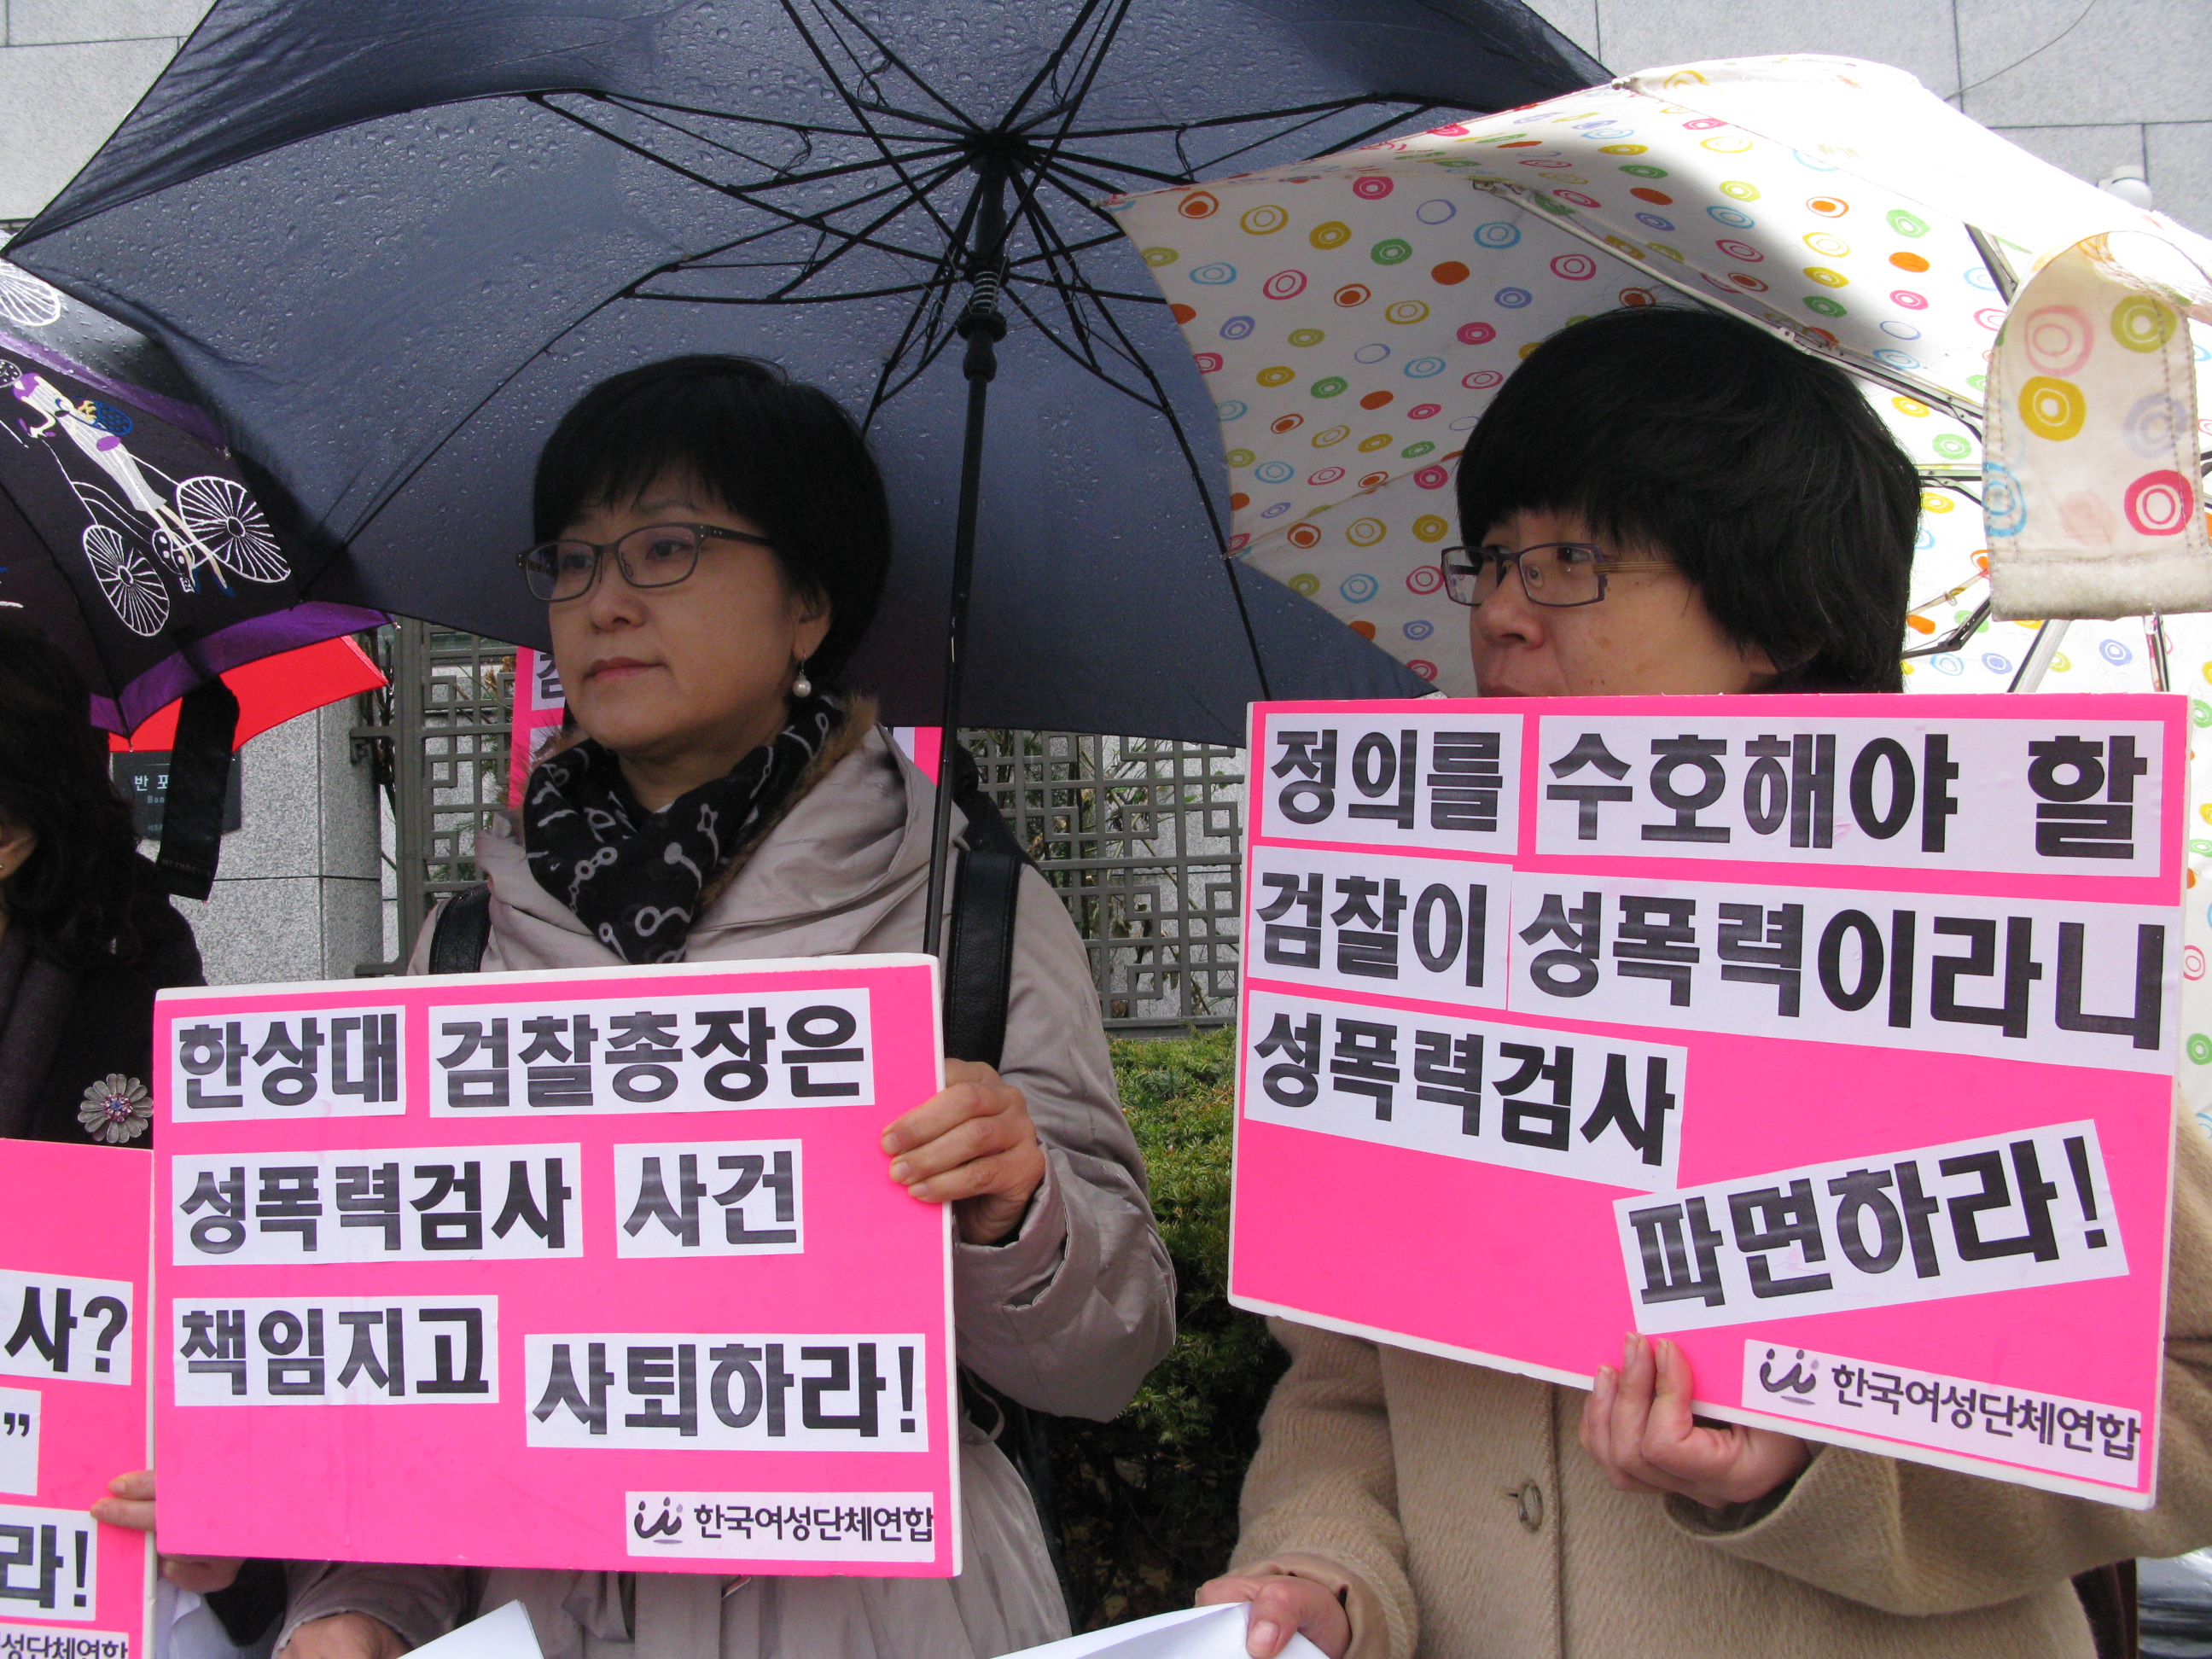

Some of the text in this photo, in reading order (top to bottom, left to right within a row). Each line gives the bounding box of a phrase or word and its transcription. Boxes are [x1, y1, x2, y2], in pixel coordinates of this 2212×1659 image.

[1271, 729, 2148, 859] 정의를 수호해야 할
[1255, 872, 2165, 1051] 검찰이 성폭력이라니
[179, 1005, 864, 1109] 한상대 검찰총장은
[1254, 1012, 1676, 1167] 성폭력검사
[179, 1150, 797, 1252] 성폭력검사 사건
[1628, 1135, 2108, 1307] 파면하라!
[179, 1308, 489, 1397] 책임지고
[533, 1342, 916, 1438] 사퇴하라!
[1831, 1364, 2141, 1462] 한국여성단체연합
[694, 1505, 934, 1542] 한국여성단체연합
